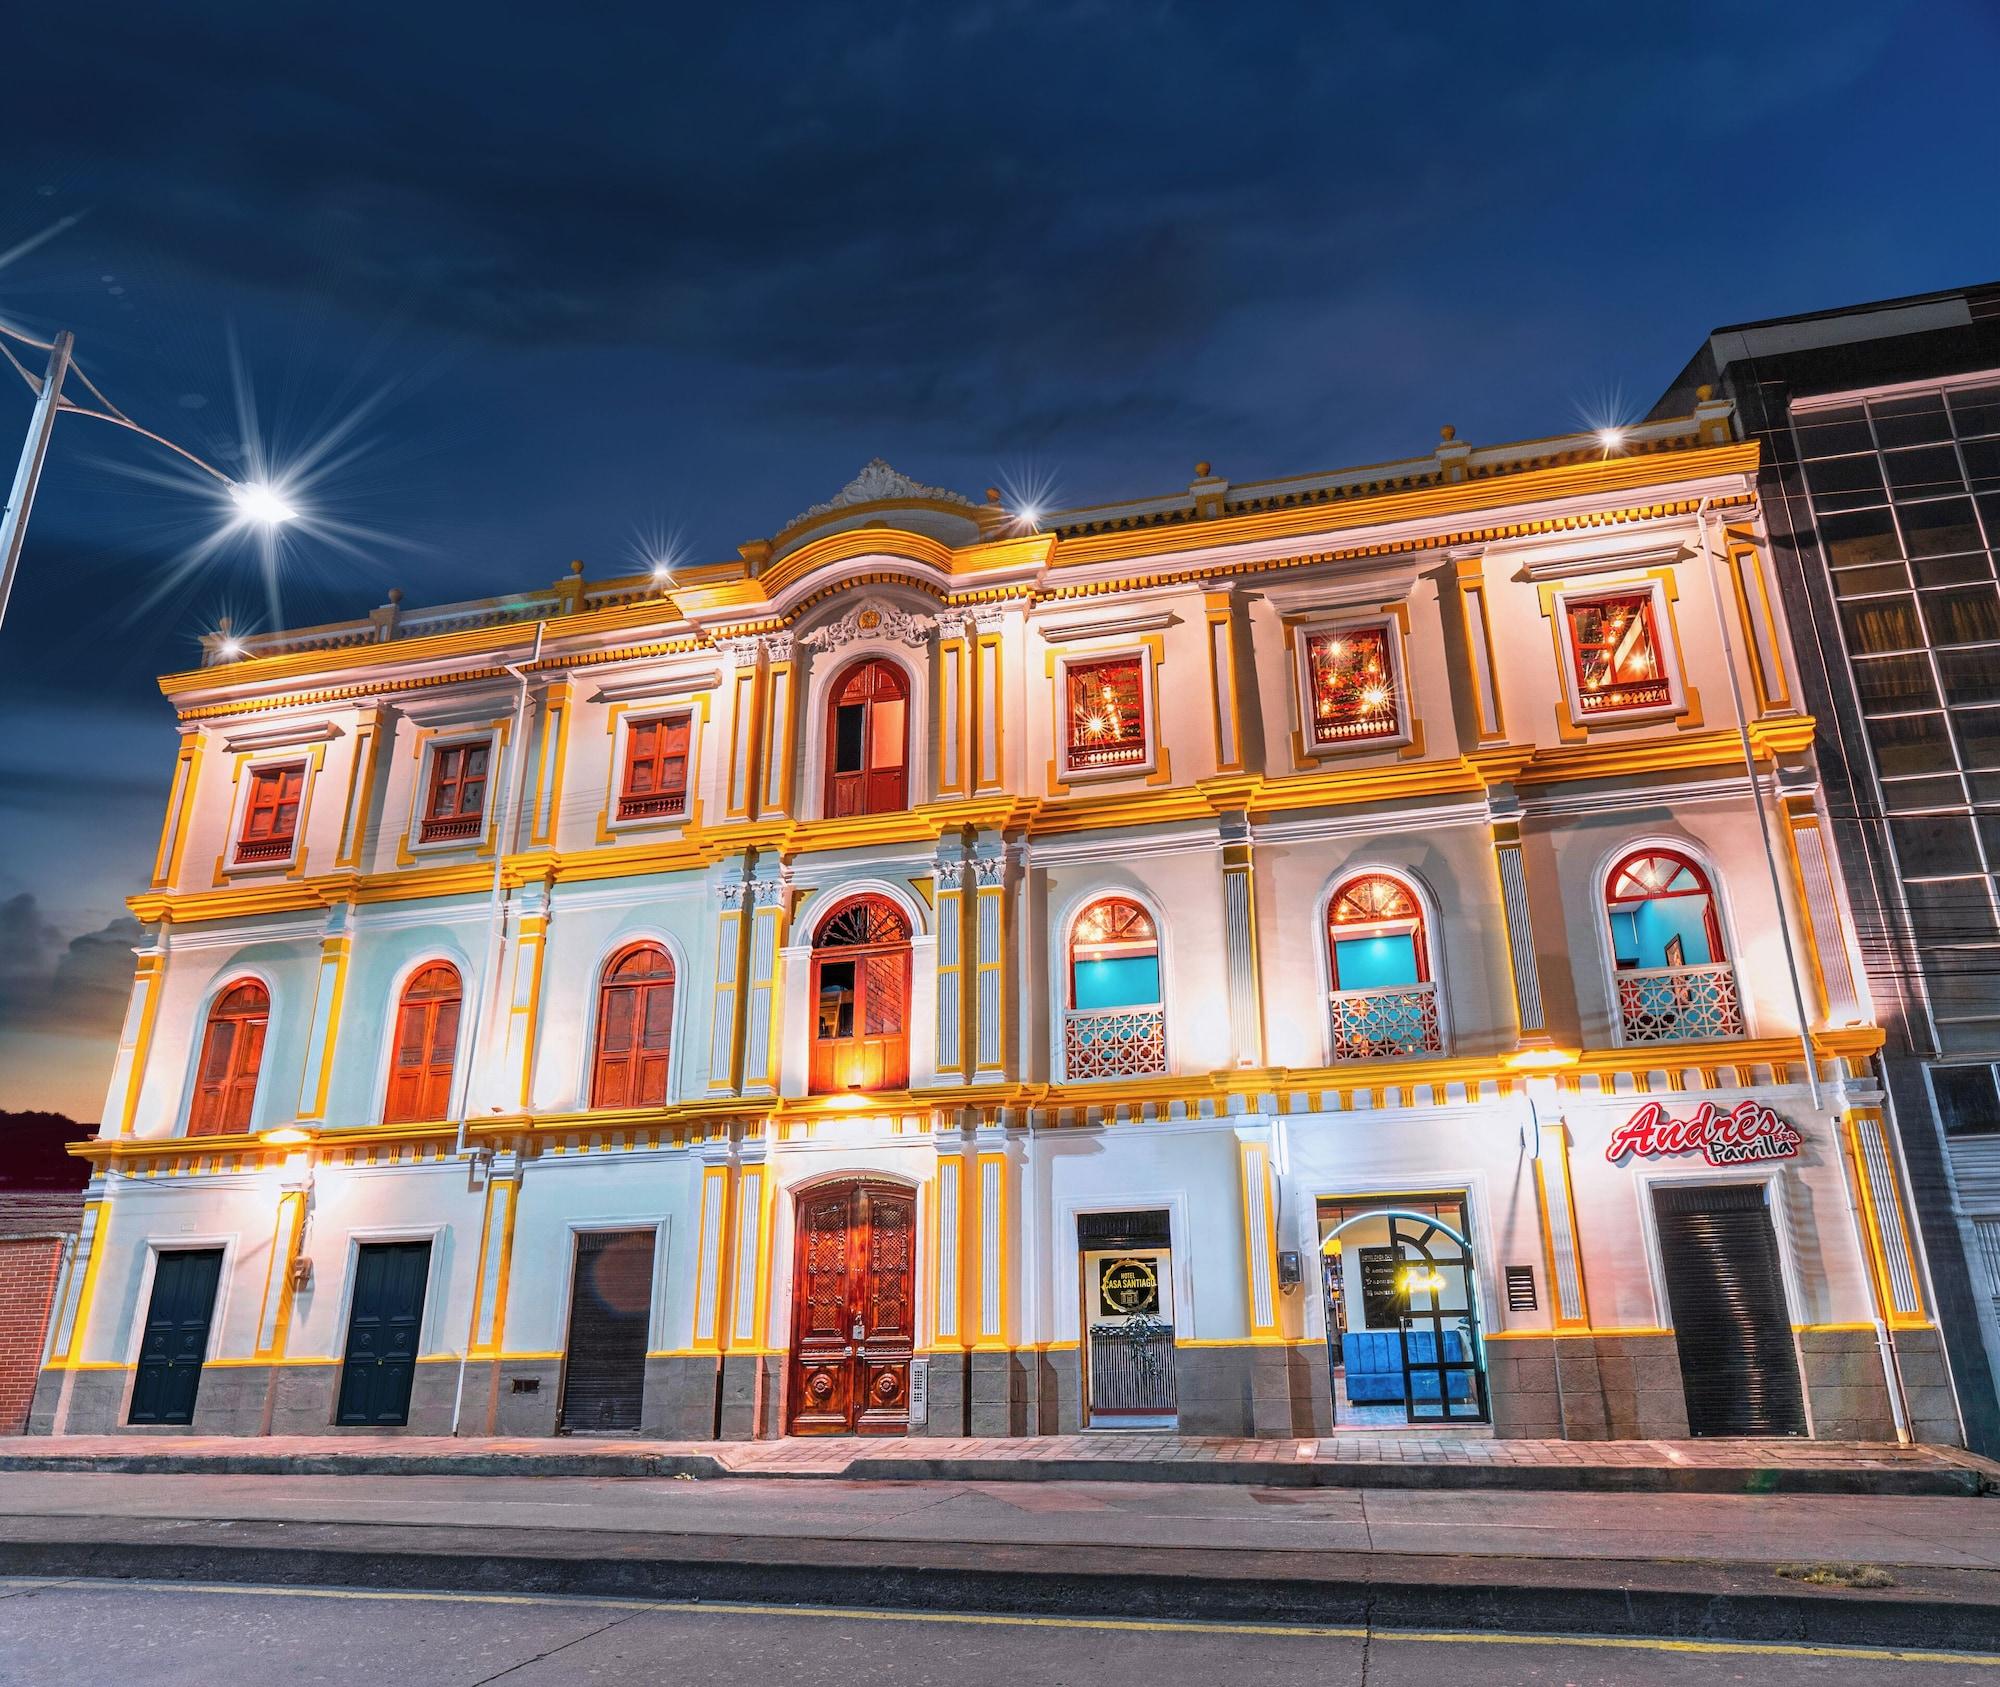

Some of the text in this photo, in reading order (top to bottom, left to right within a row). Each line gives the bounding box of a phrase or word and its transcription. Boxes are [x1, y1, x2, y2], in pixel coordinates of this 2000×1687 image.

[1608, 1102, 1786, 1160] Andrés
[1773, 1131, 1799, 1143] BBQ
[1708, 1134, 1794, 1163] Parrilla
[1104, 1278, 1156, 1288] CASA SANTIAGO
